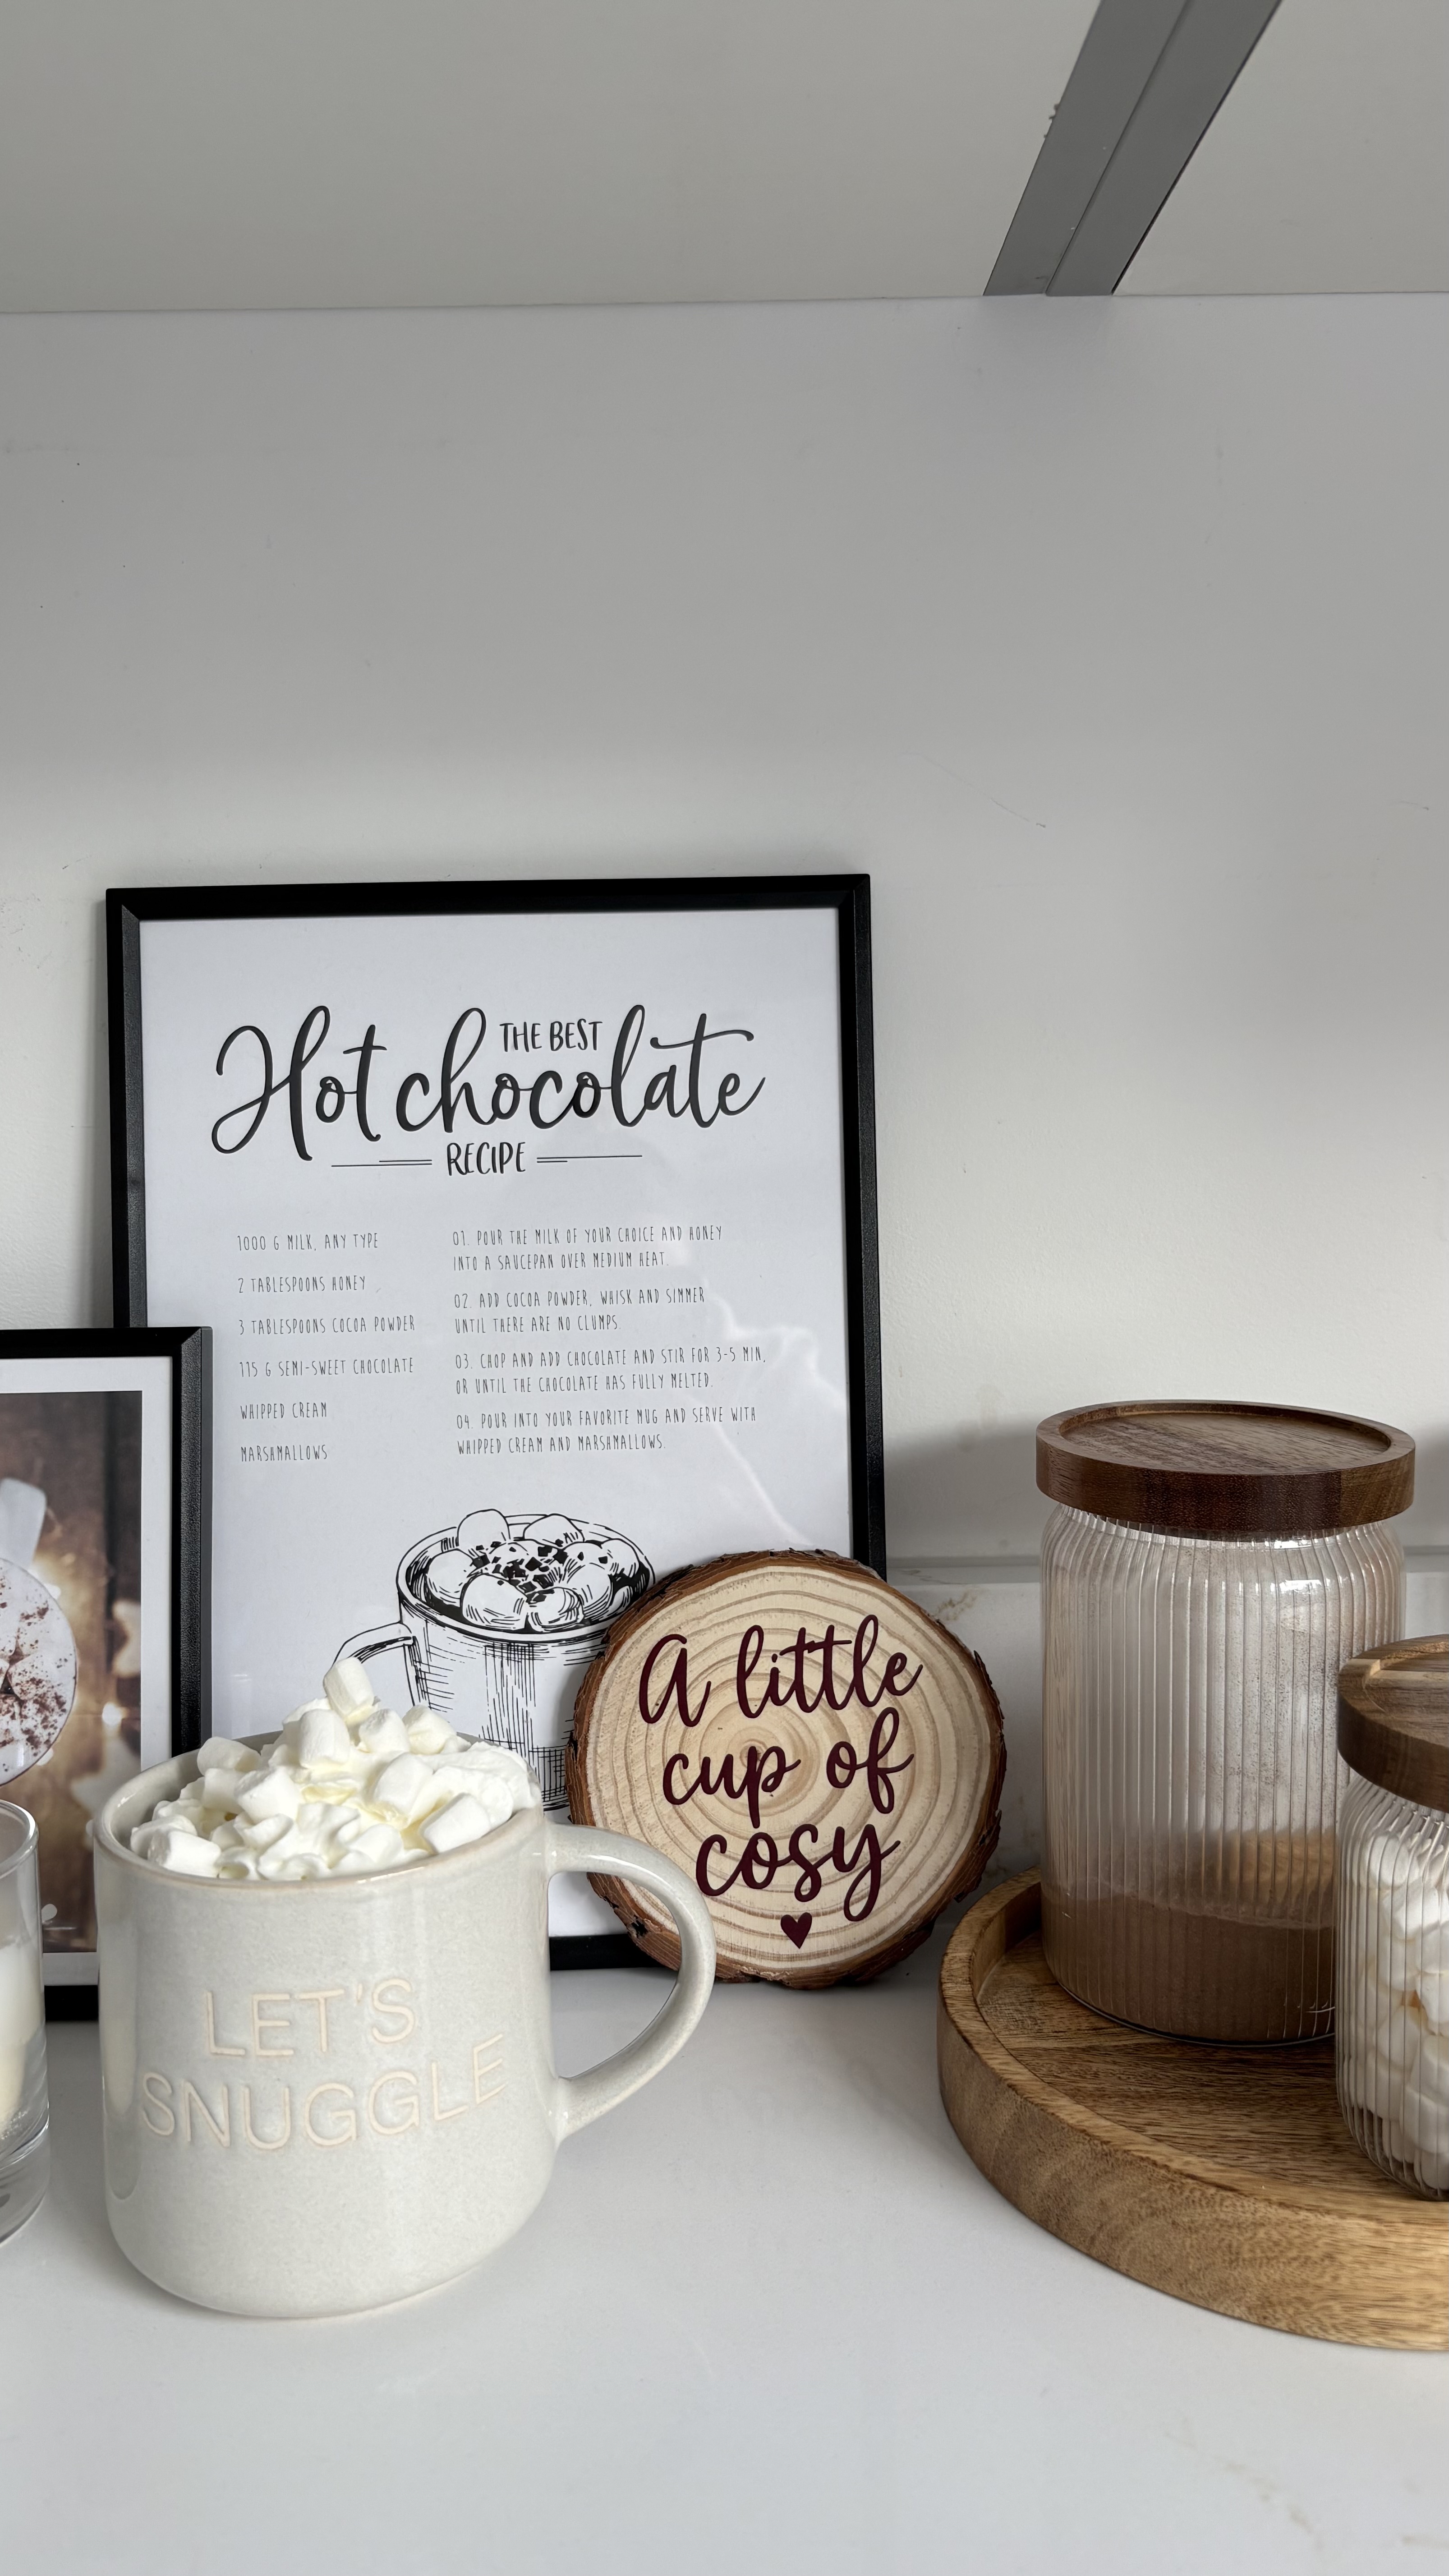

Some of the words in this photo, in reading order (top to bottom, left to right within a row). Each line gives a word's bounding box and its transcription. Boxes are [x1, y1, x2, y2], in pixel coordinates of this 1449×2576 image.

[500, 1022, 542, 1052] THE
[550, 1019, 603, 1051] BEST
[212, 1006, 389, 1162] Hot
[396, 1005, 765, 1133] chocolate
[447, 1142, 525, 1176] RECIPE
[237, 1235, 266, 1251] 1000
[274, 1236, 279, 1251] G
[287, 1233, 316, 1251] MILK,
[325, 1234, 346, 1249] ANY
[353, 1233, 378, 1248] TYPE
[453, 1230, 470, 1246] 01.
[477, 1229, 503, 1246] POUR
[509, 1229, 527, 1245] THE
[535, 1228, 560, 1244] MILK
[566, 1228, 577, 1244] OF
[584, 1226, 611, 1243] YOUR
[618, 1226, 654, 1242] CHOICE
[662, 1226, 682, 1242] AND
[689, 1225, 722, 1241] HONEY
[454, 1256, 477, 1271] INTO
[485, 1256, 491, 1271] A
[498, 1254, 553, 1270] SAUCEPAN
[561, 1252, 586, 1269] OVER
[593, 1251, 632, 1268] MEDIUM
[639, 1251, 669, 1267] HEAT.
[238, 1278, 244, 1293] 2
[250, 1276, 325, 1293] TABLESPOONS
[332, 1275, 365, 1291] HONEY
[454, 1293, 472, 1309] 02.
[479, 1293, 499, 1308] ADD
[506, 1292, 540, 1307] COCOA
[548, 1289, 592, 1307] POWDER,
[600, 1288, 632, 1305] WHISK
[639, 1288, 659, 1304] AND
[666, 1286, 704, 1304] SIMMER
[239, 1320, 244, 1335] 3
[251, 1318, 326, 1335] TABLESPOONS
[332, 1317, 367, 1333] COCOA
[374, 1315, 415, 1332] POWDER
[455, 1317, 486, 1334] UNTIL
[492, 1316, 524, 1333] THERE
[532, 1316, 550, 1332] ARE
[558, 1316, 570, 1331] NO
[578, 1314, 621, 1331] CLUMPS.
[239, 1361, 258, 1377] 115
[265, 1362, 271, 1377] G
[278, 1359, 346, 1376] SEMI-SWEET
[353, 1357, 413, 1375] CHOCOLATE
[455, 1353, 473, 1369] 03.
[480, 1352, 506, 1369] CHOP
[513, 1352, 533, 1368] AND
[541, 1351, 560, 1367] ADD
[567, 1349, 626, 1366] CHOCOLATE
[634, 1349, 654, 1364] AND
[661, 1347, 685, 1364] STIR
[692, 1346, 709, 1363] FOR
[716, 1347, 736, 1362] 3-5
[743, 1346, 766, 1363] MIN,
[456, 1378, 468, 1394] OR
[475, 1377, 506, 1394] UNTIL
[513, 1377, 531, 1393] THE
[539, 1375, 598, 1392] CHOCOLATE
[606, 1375, 626, 1390] HAS
[632, 1373, 663, 1389] FULLY
[671, 1372, 713, 1389] MELTED.
[240, 1403, 285, 1420] WHIPPED
[292, 1401, 327, 1418] CREAM
[456, 1414, 474, 1429] 04.
[481, 1412, 507, 1429] POUR
[514, 1412, 538, 1428] INTO
[545, 1410, 572, 1427] YOUR
[579, 1409, 629, 1426] FAVORITE
[637, 1408, 658, 1424] MUG
[665, 1408, 685, 1424] AND
[692, 1406, 723, 1423] SERVE
[731, 1407, 756, 1422] WITH
[241, 1444, 327, 1462] MARSHMALLOWS
[457, 1438, 501, 1455] WHIPPED
[508, 1436, 543, 1454] CREAM
[550, 1436, 570, 1452] AND
[578, 1434, 666, 1451] MARSHMALLOWS.
[639, 1634, 711, 1727] A
[736, 1614, 924, 1719] little
[663, 1746, 801, 1828] cup
[827, 1707, 914, 1814] of
[696, 1824, 901, 1923] cosy
[205, 1979, 416, 2056] LET'S
[142, 2033, 507, 2149] SNUGGLE
